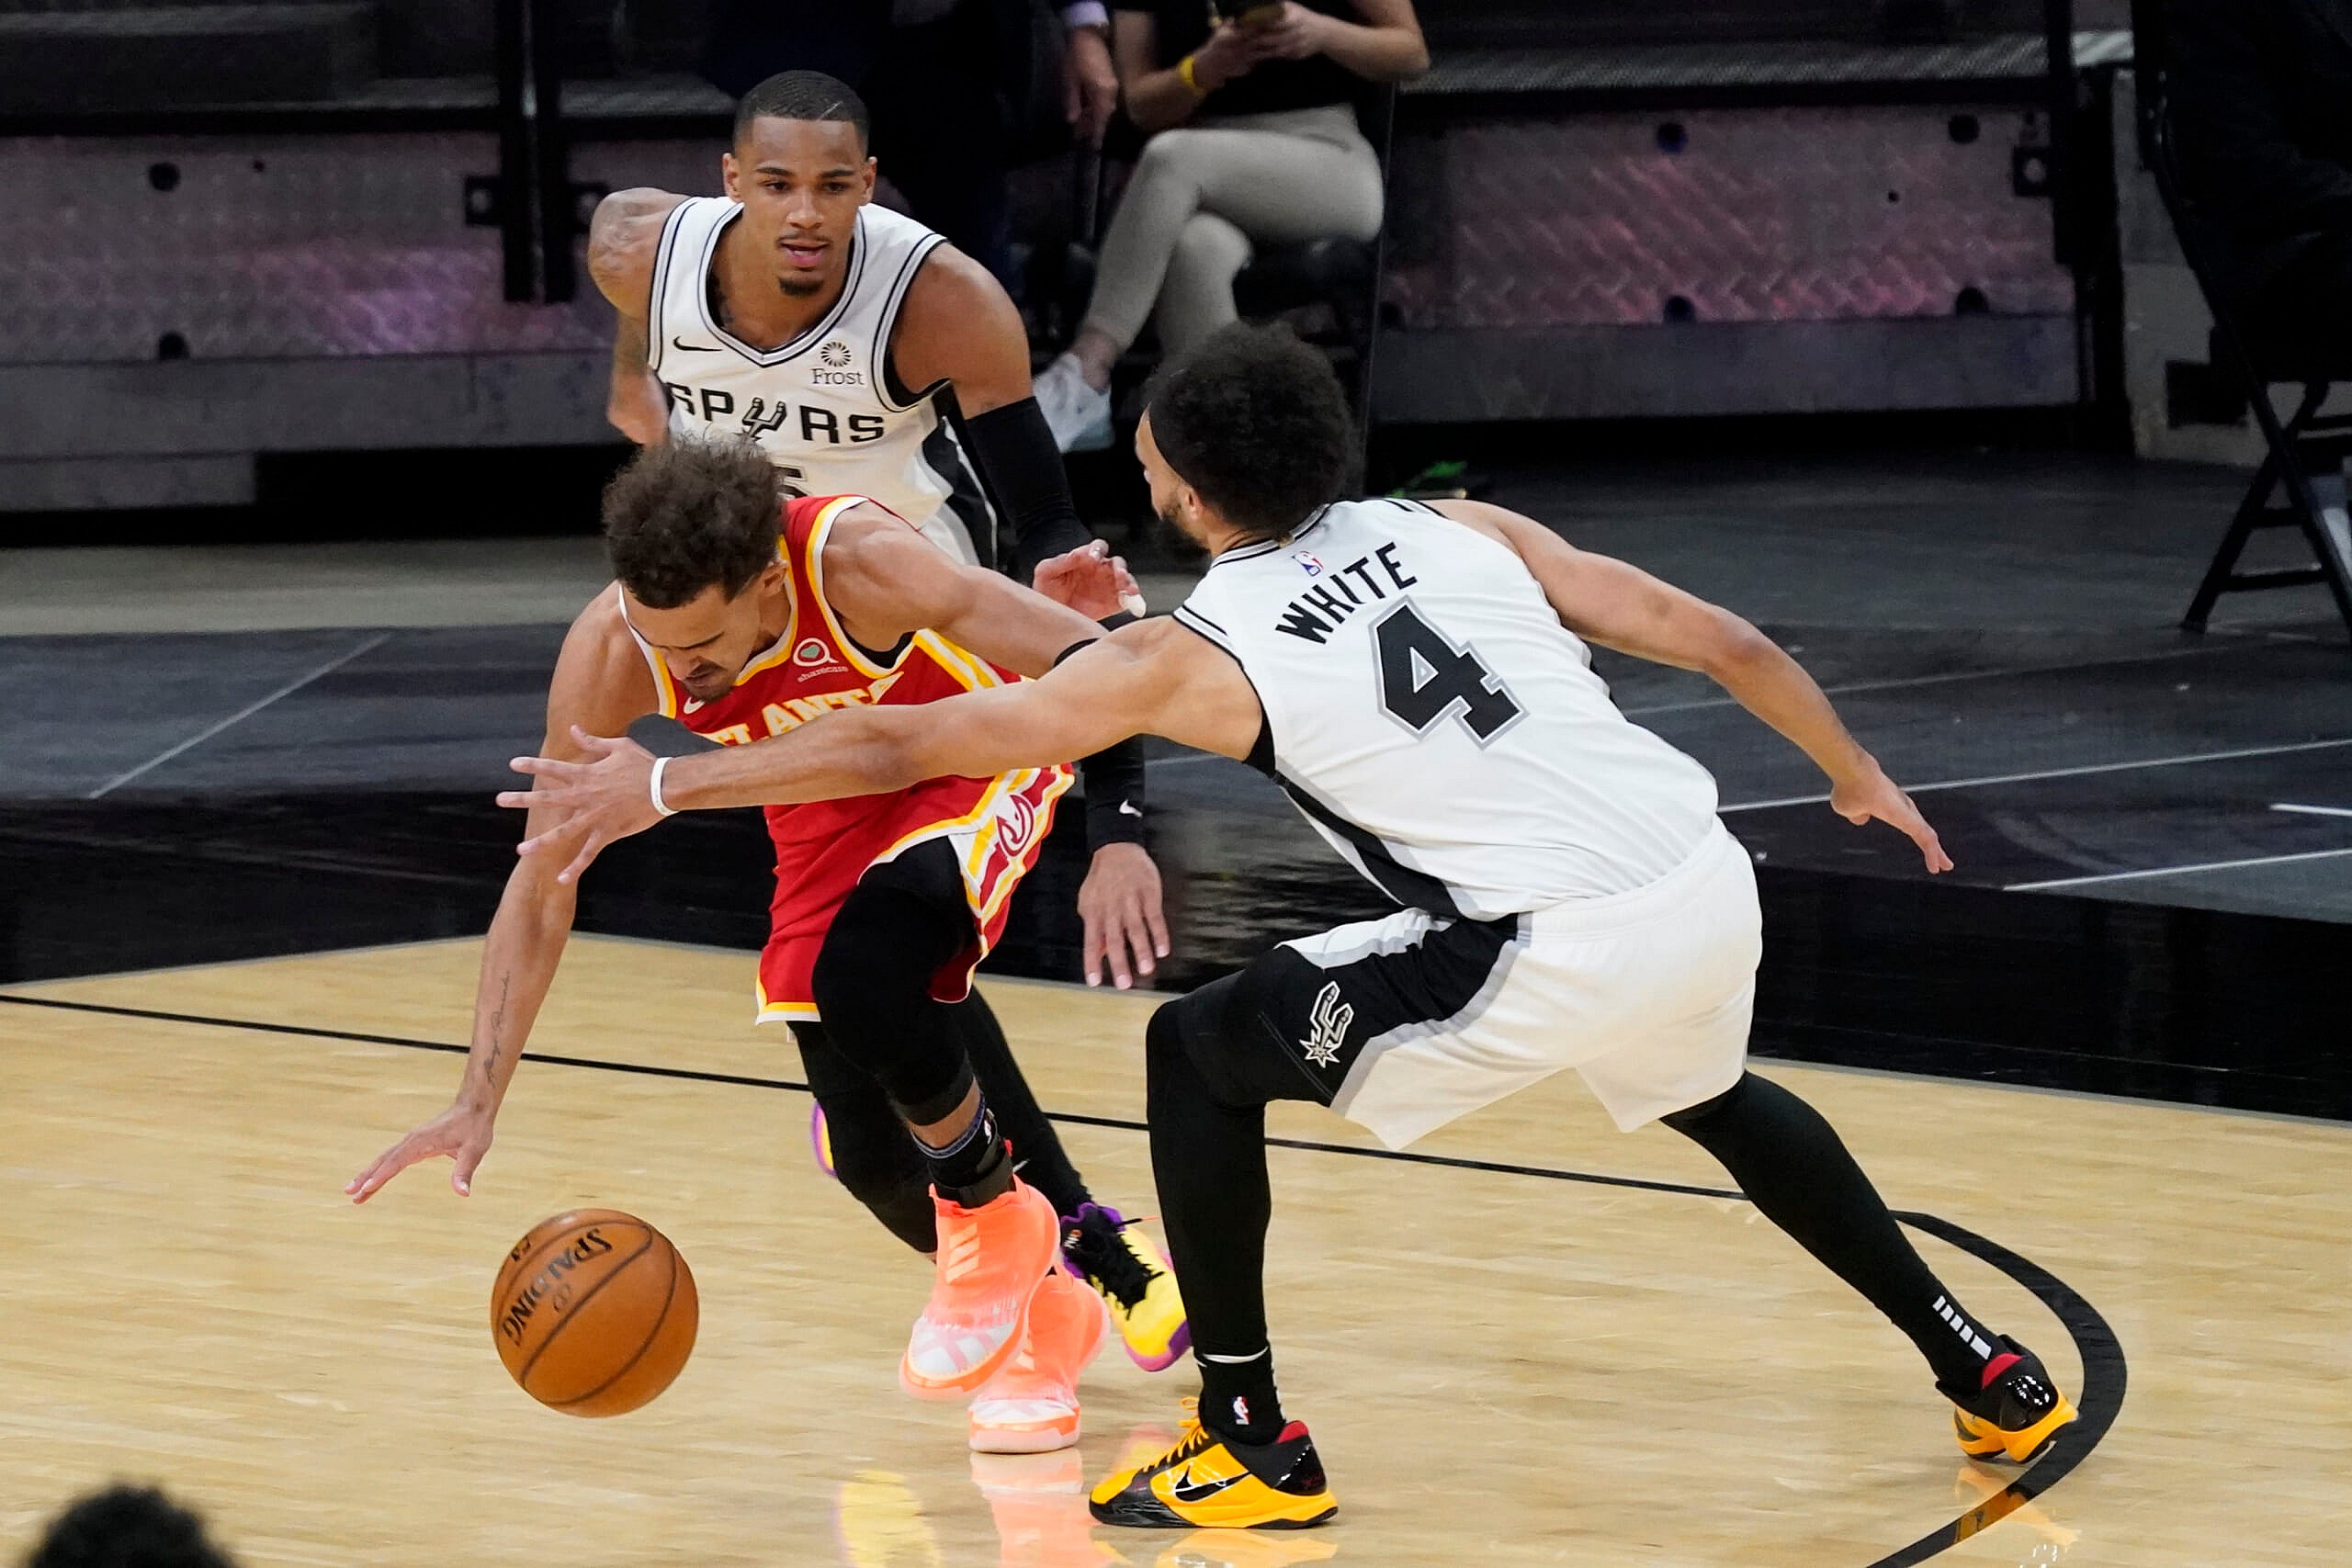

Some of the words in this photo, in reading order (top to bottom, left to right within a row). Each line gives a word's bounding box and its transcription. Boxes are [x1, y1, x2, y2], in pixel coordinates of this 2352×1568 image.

[812, 367, 865, 385] Frost
[1274, 541, 1418, 645] WHITE
[1367, 594, 1531, 751] 4
[503, 1227, 613, 1347] SPALDING
